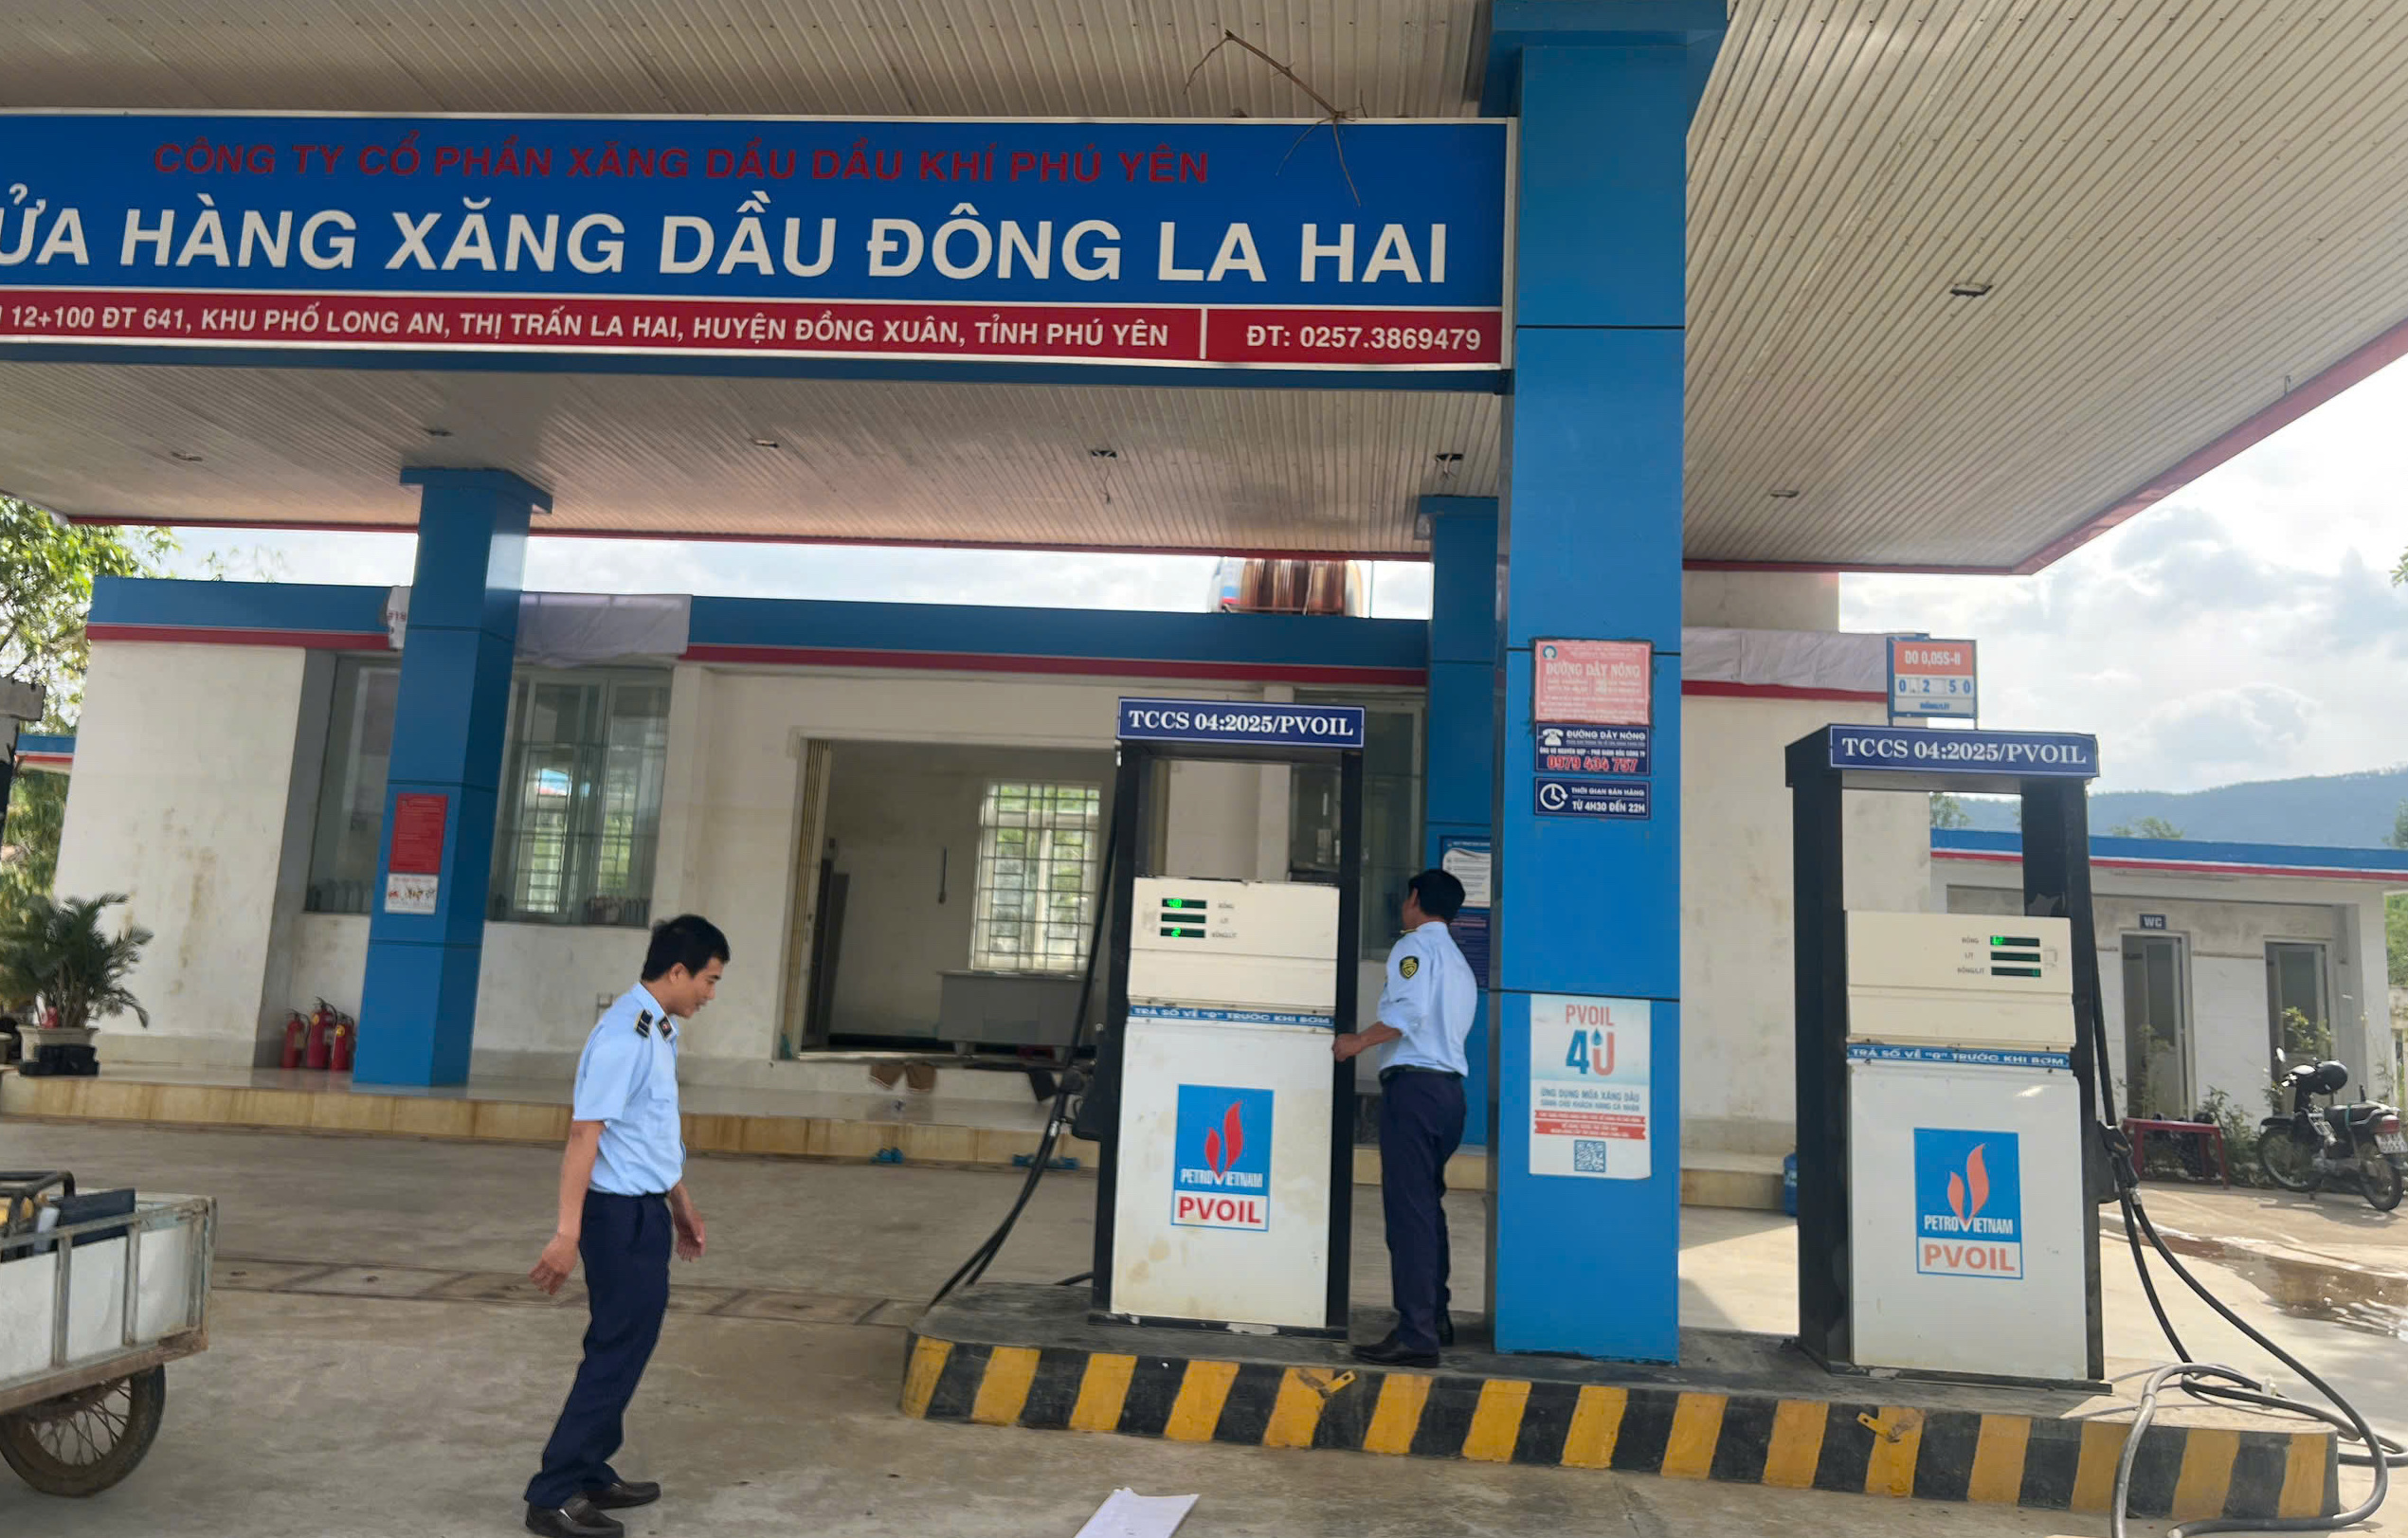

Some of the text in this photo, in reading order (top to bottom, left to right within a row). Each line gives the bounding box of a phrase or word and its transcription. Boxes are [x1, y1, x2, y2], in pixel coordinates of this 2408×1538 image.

[154, 136, 277, 174] CÔNG
[292, 144, 345, 174] TY
[357, 130, 421, 176] CỔ
[566, 140, 690, 179] XĂNG
[918, 142, 997, 182] KHÍ
[1009, 143, 1102, 182] PHÚ
[1118, 144, 1208, 183] YÊN
[119, 193, 357, 270] HÀNG
[384, 196, 625, 275] XĂNG
[659, 190, 837, 278] DẦU
[866, 202, 1121, 281] ĐÔNG
[1158, 222, 1267, 282] LA
[1299, 224, 1446, 283] HAI
[11, 305, 95, 329] 12+100
[101, 306, 137, 329] ĐT
[143, 307, 191, 334] 641,
[201, 308, 257, 331] KHU
[263, 301, 320, 333] PHỐ
[326, 309, 400, 335] LONG
[407, 313, 451, 338] AN,
[460, 313, 501, 340] THỊ
[510, 305, 582, 336] TRẤN
[589, 316, 624, 337] LA
[632, 316, 684, 342] HAI,
[693, 313, 787, 344] HUYỆN
[795, 310, 875, 343] ĐỒNG
[882, 316, 966, 348] XUÂN,
[974, 314, 1039, 344] TỈNH
[1046, 318, 1104, 346] PHÚ
[1113, 318, 1168, 348] YÊN
[1246, 324, 1482, 352] ĐT: 0257.3869479
[1905, 650, 1919, 665] DO
[1129, 710, 1354, 736] TCCS 04:2025/PVOIL
[1841, 737, 2087, 764] TCCS 04:2025/PVOIL
[2144, 916, 2163, 928] WC
[1566, 1004, 1615, 1026] PVOIL
[2003, 1056, 2027, 1064] KHI
[1178, 1196, 1262, 1223] PVOIL
[1924, 1215, 2014, 1235] PETROVIETNAM
[1924, 1244, 2015, 1271] PVOIL
